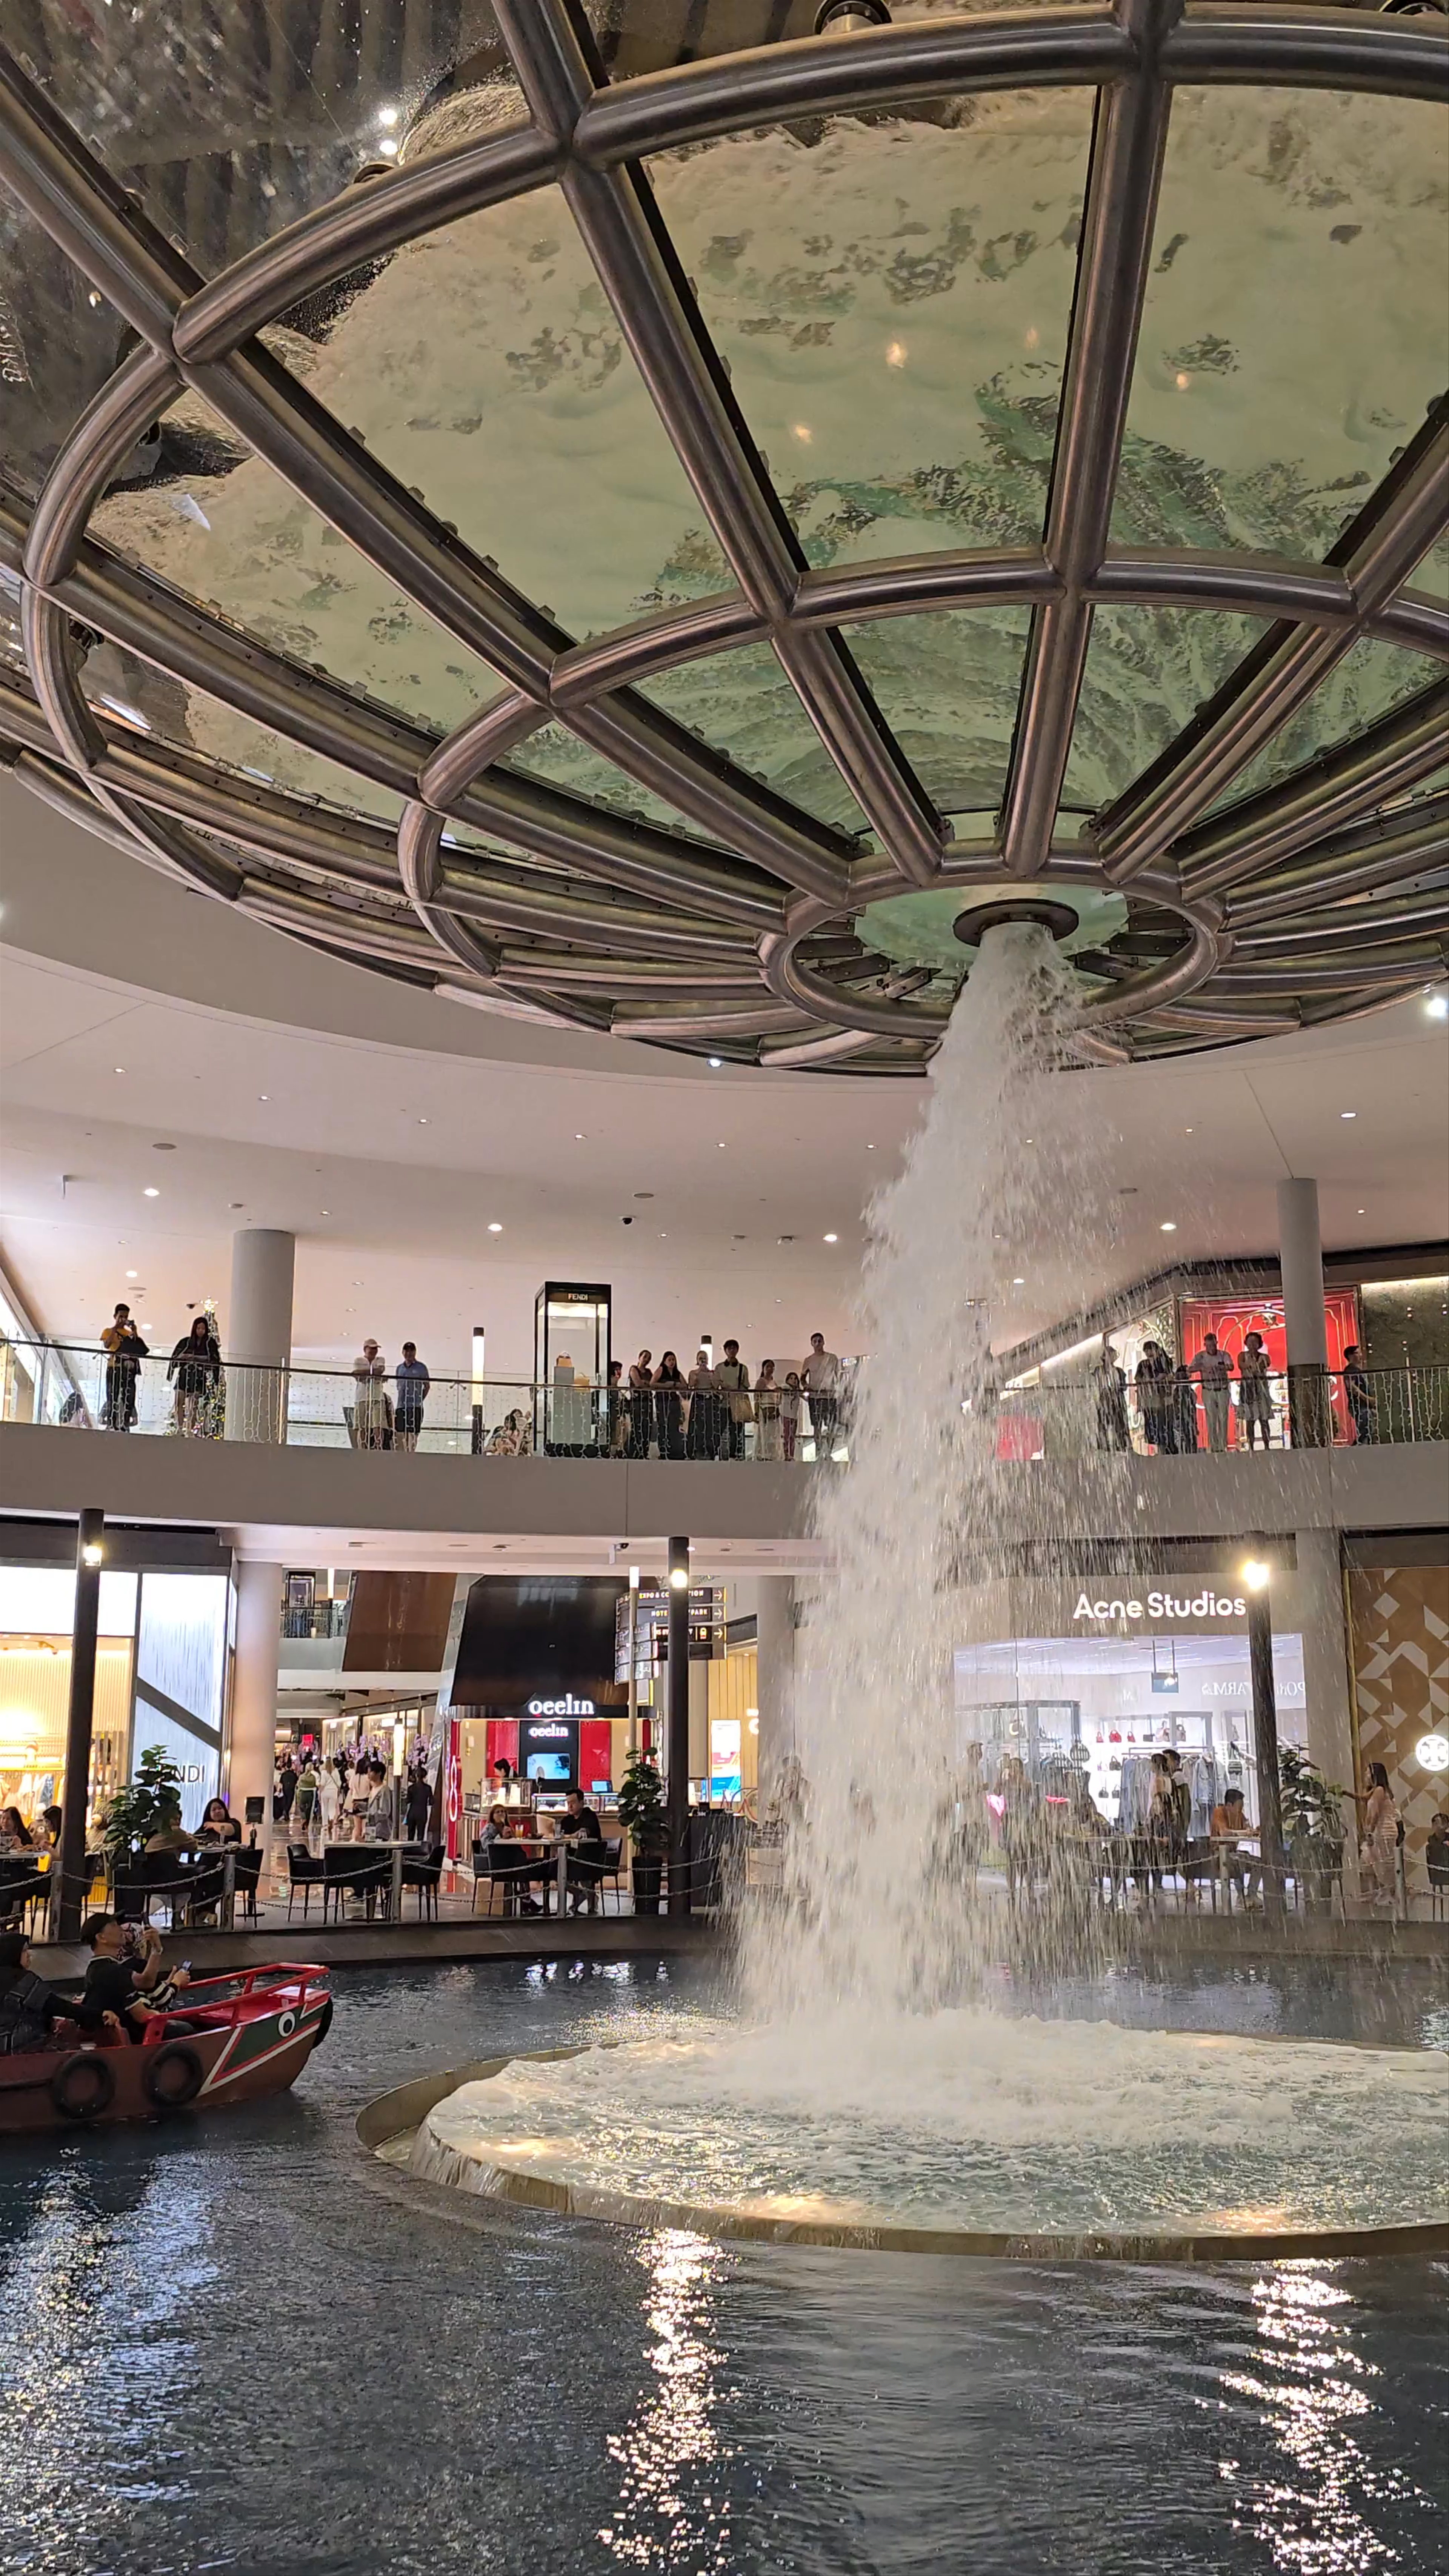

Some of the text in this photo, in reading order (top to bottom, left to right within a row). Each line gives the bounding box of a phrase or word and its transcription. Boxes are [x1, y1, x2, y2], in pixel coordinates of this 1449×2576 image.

[1073, 1591, 1246, 1619] Acne Studios
[175, 1765, 205, 1783] NDI
